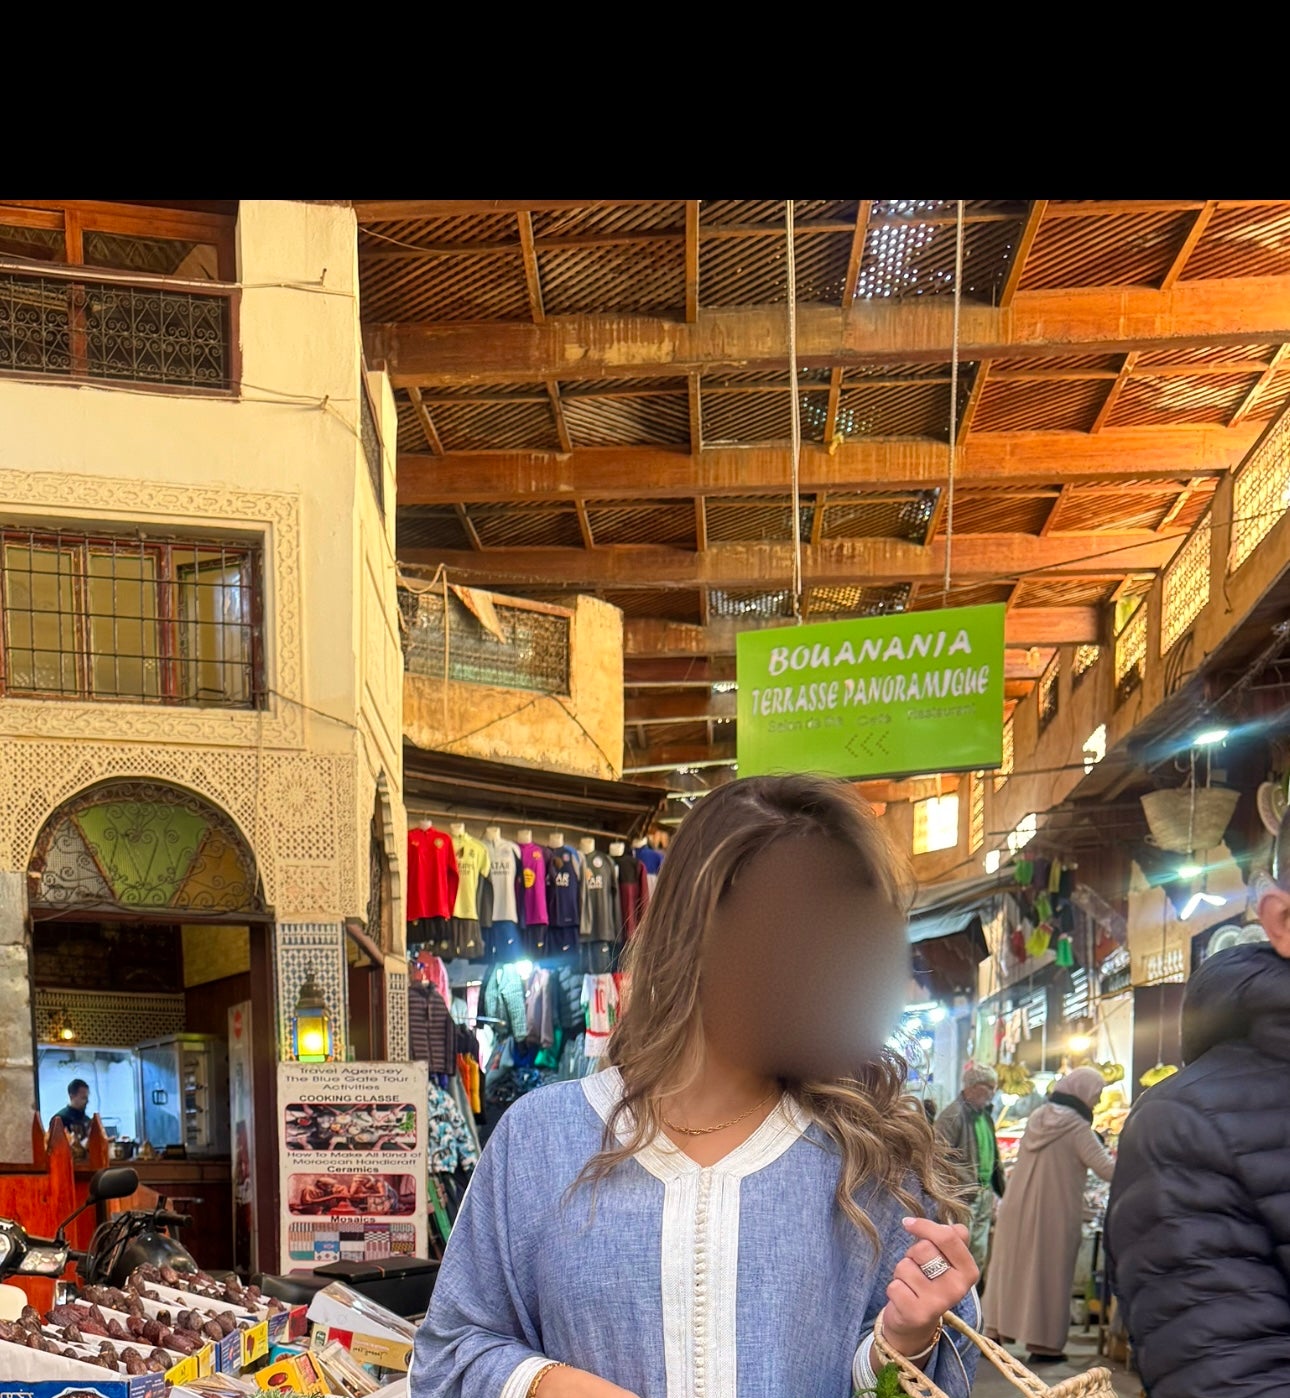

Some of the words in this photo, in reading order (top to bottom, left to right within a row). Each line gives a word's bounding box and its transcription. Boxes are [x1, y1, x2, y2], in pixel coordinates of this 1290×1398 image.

[768, 629, 972, 676] BOUANANIA
[751, 680, 839, 716] TERRASSE
[843, 665, 989, 707] PANORAMIQUE
